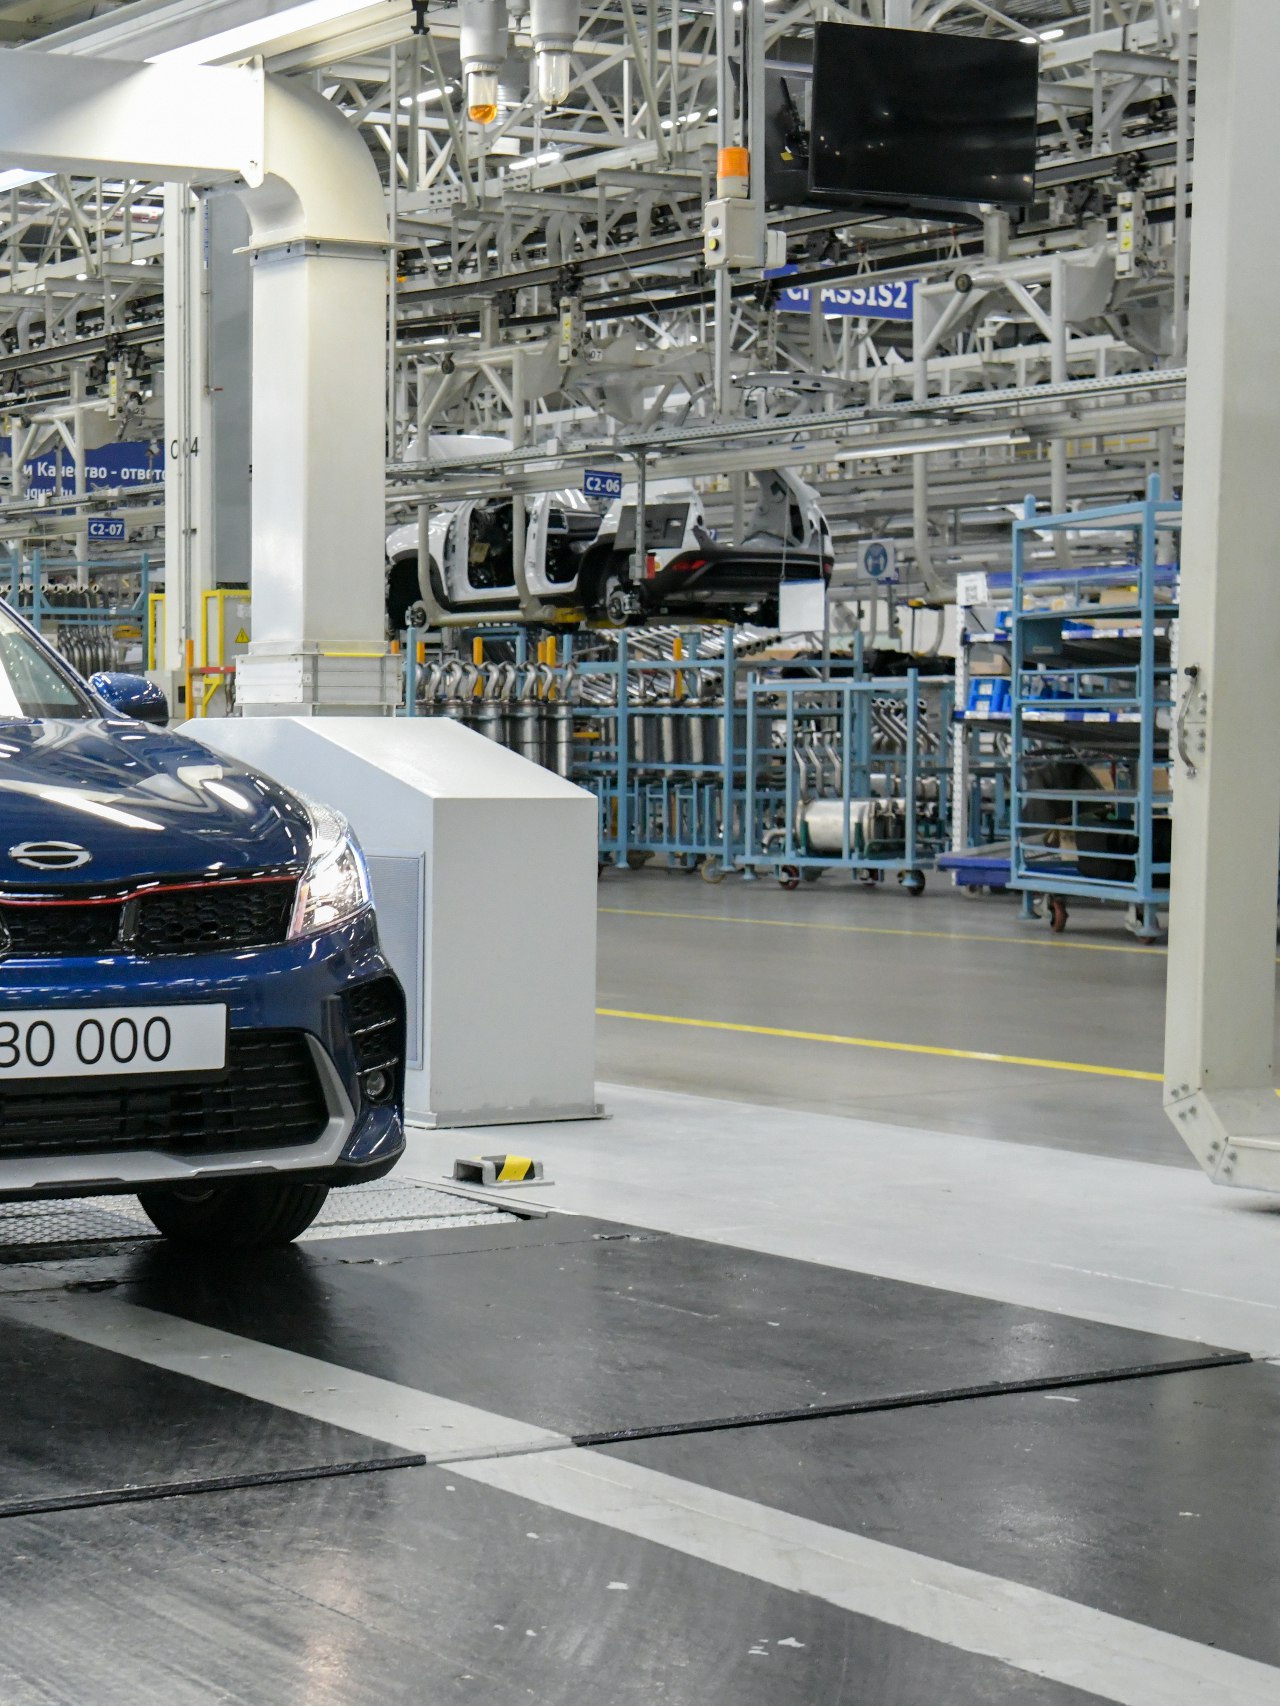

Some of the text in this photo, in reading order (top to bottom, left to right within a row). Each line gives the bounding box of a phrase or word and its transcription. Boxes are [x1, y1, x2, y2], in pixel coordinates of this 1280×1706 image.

[37, 461, 108, 479] Каетво
[586, 476, 620, 493] C2-06
[90, 523, 123, 536] C2-07
[76, 1016, 171, 1065] 000
